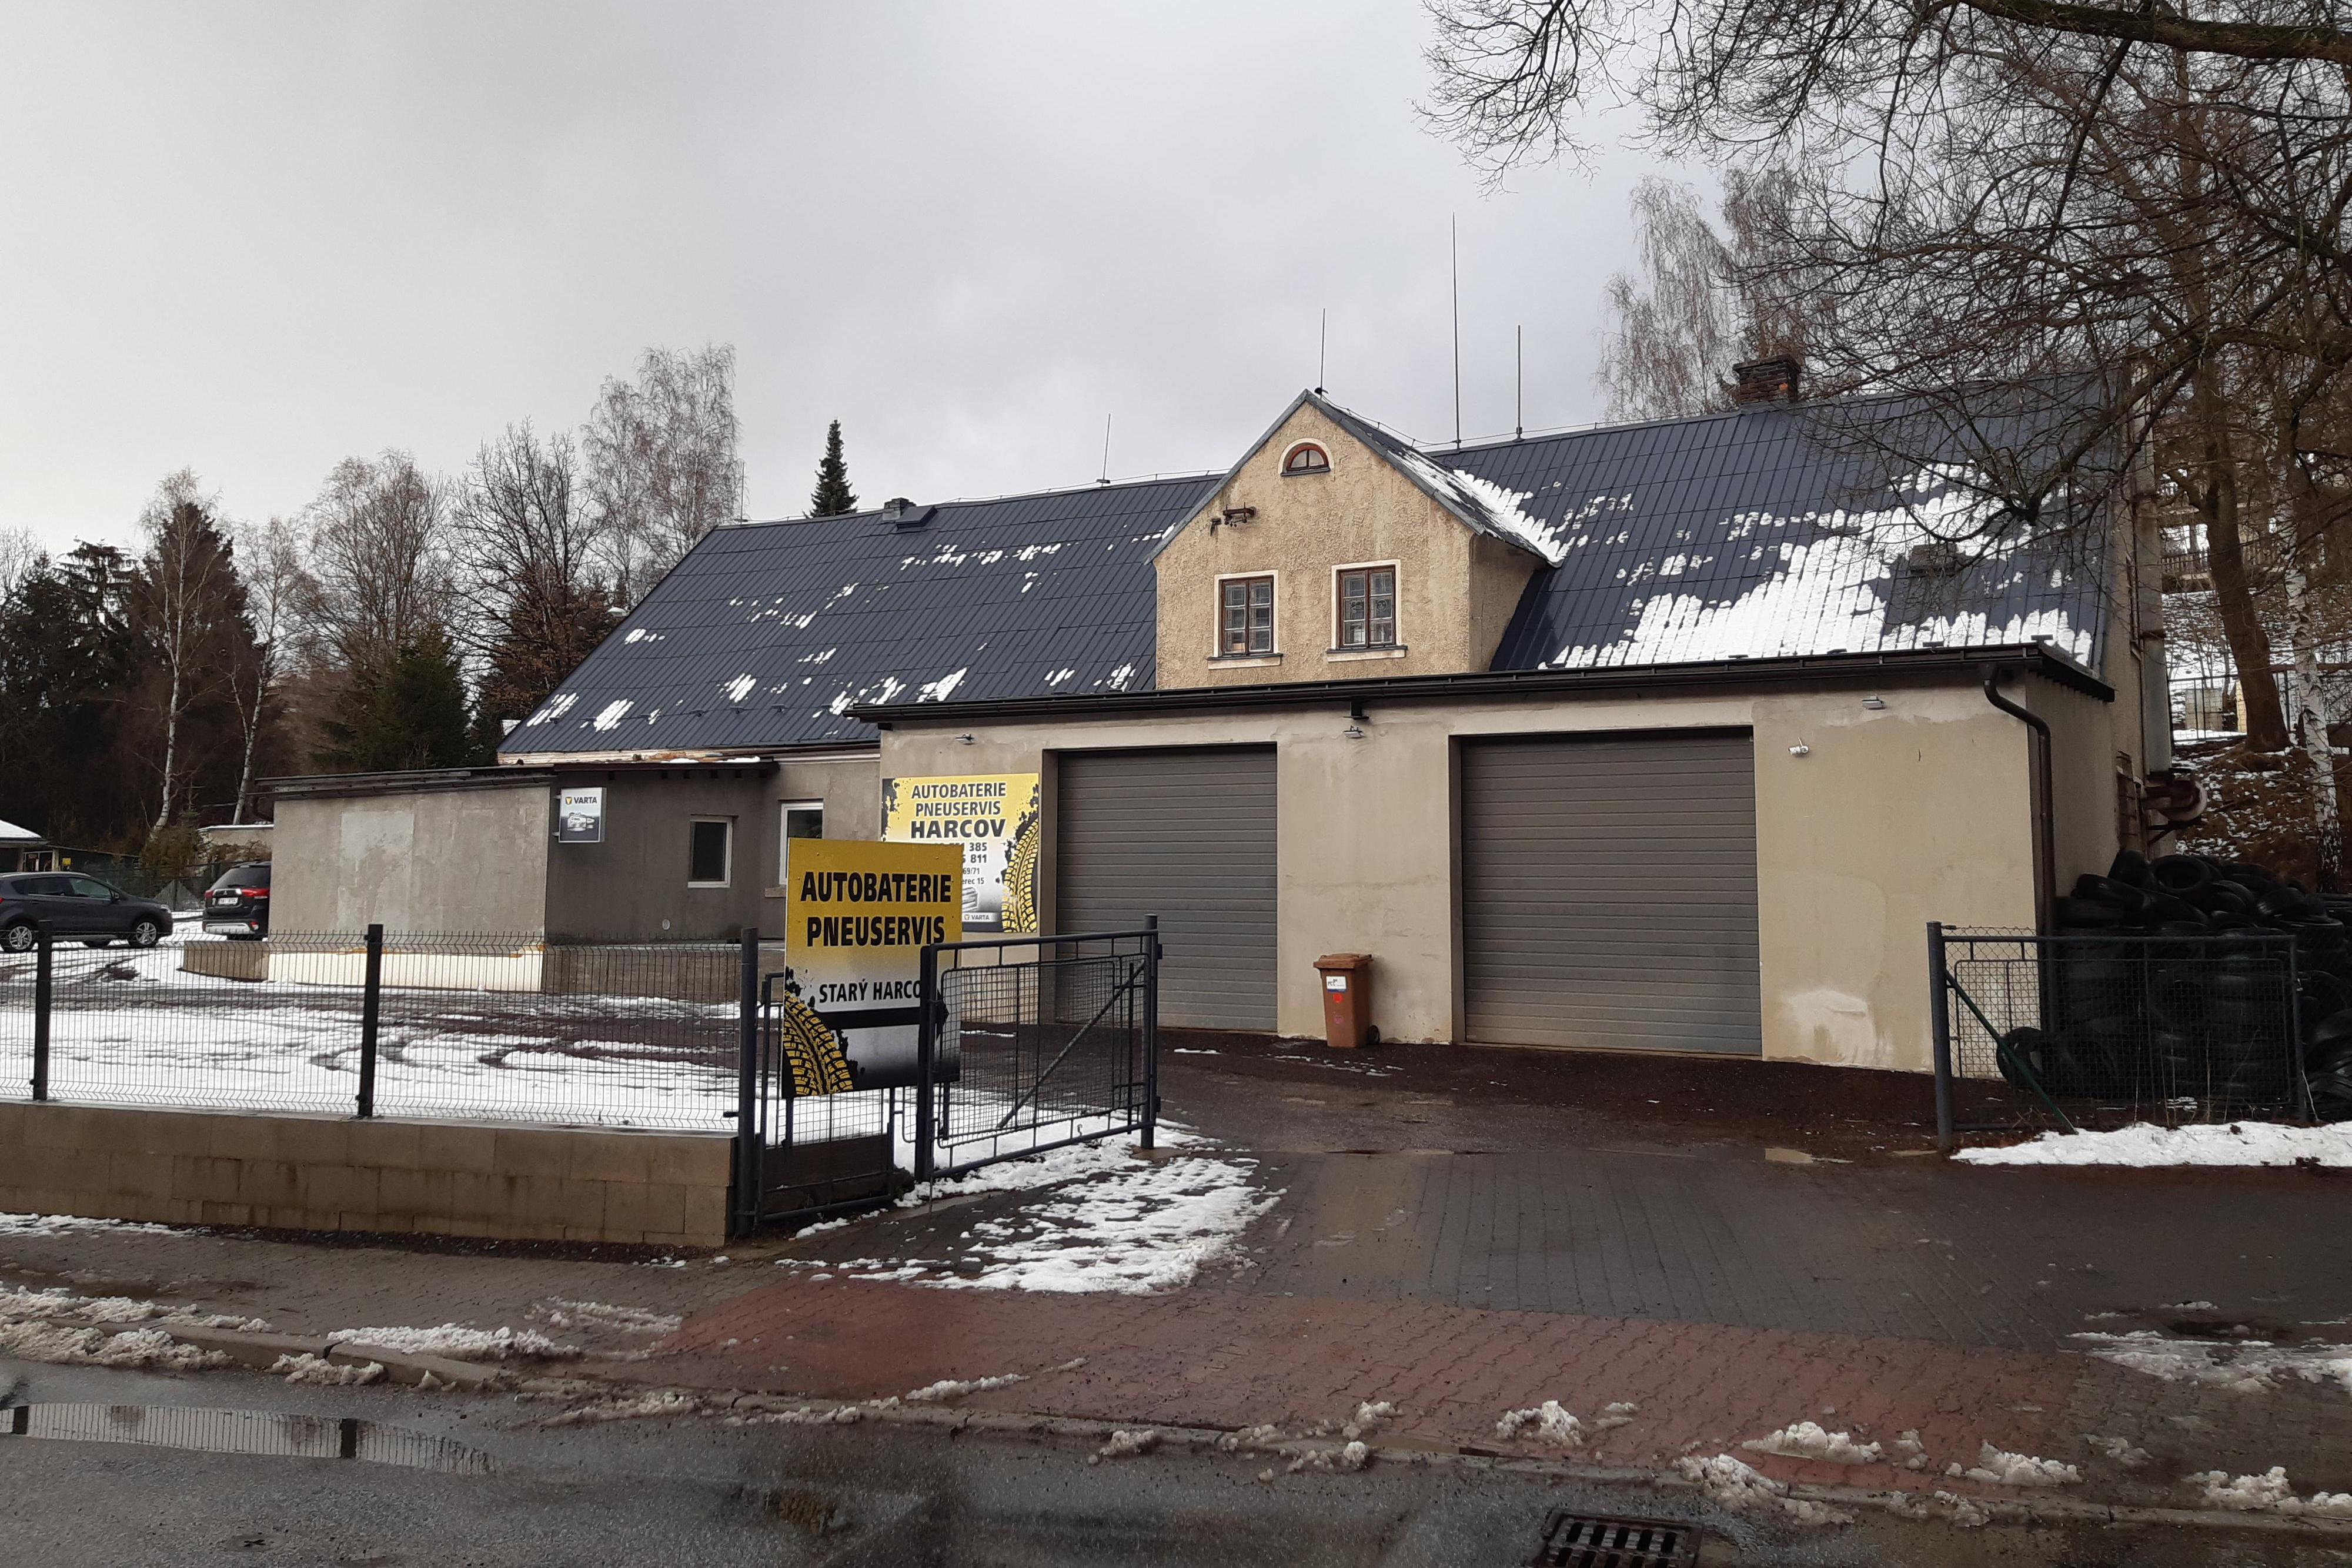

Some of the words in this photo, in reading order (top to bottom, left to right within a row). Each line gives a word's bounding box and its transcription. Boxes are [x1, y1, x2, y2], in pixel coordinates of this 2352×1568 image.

[911, 783, 1006, 798] AUTOBATERIE
[916, 801, 1000, 817] PNEUSERVIS
[911, 819, 1006, 838] HARCOV
[969, 842, 987, 851] 385
[970, 854, 987, 863] 811
[800, 872, 951, 902] AUTOBATERIE
[807, 916, 945, 947] PNEUSERVIS
[819, 979, 868, 1003] STARÝ
[873, 980, 921, 1000] HARCO
